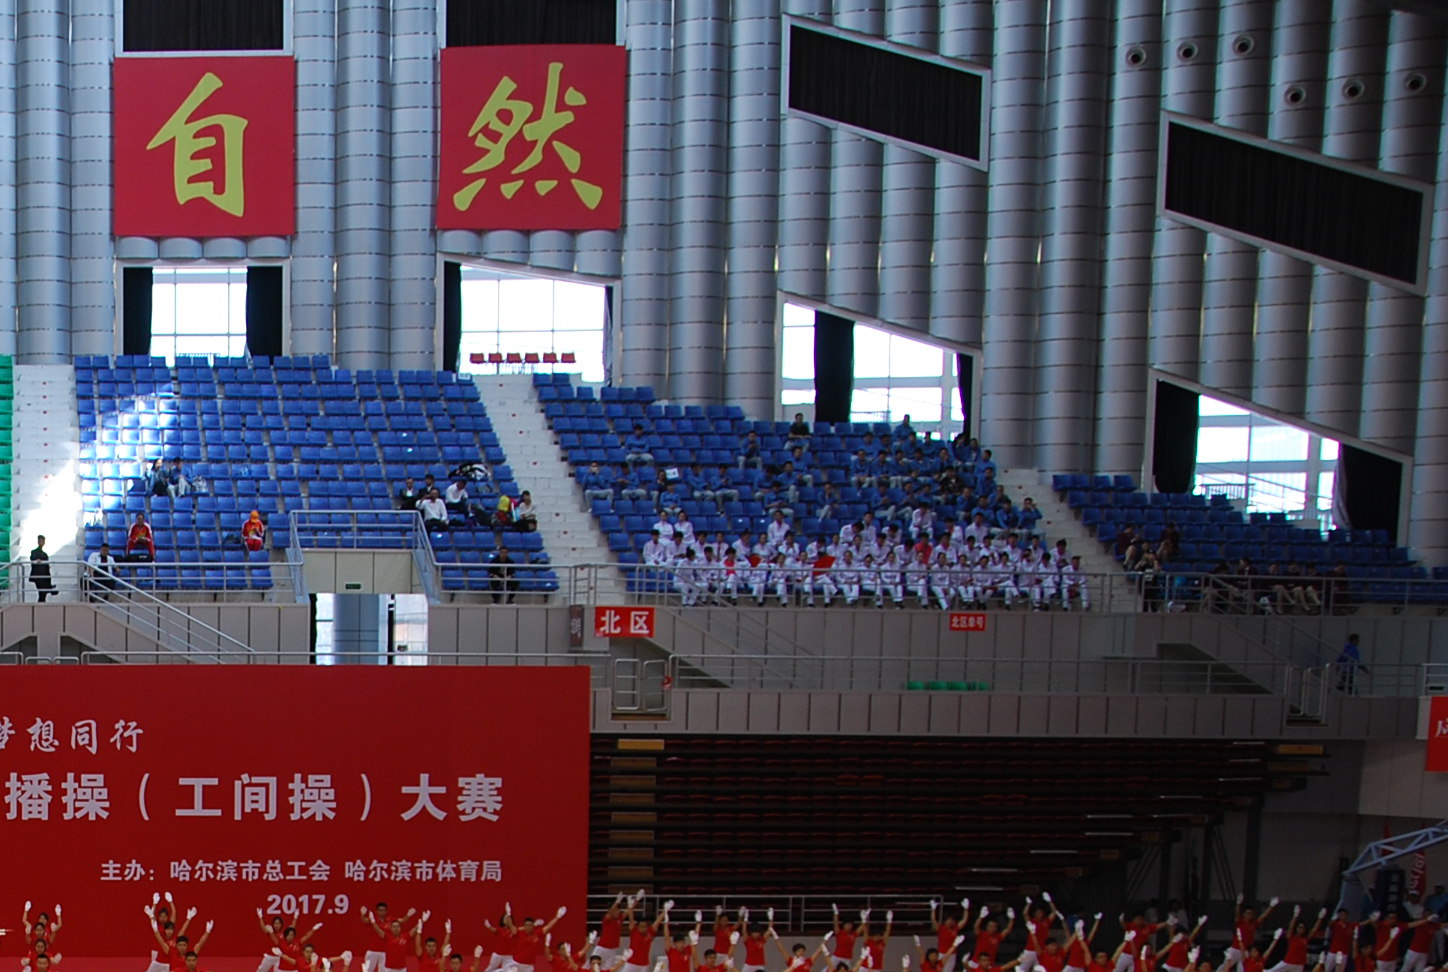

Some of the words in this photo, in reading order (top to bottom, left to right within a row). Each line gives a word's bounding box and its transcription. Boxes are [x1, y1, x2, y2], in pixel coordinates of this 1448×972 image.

[146, 72, 249, 218] 自
[453, 62, 604, 212] 然
[599, 609, 651, 635] 北区
[266, 894, 350, 915] 2017.9
